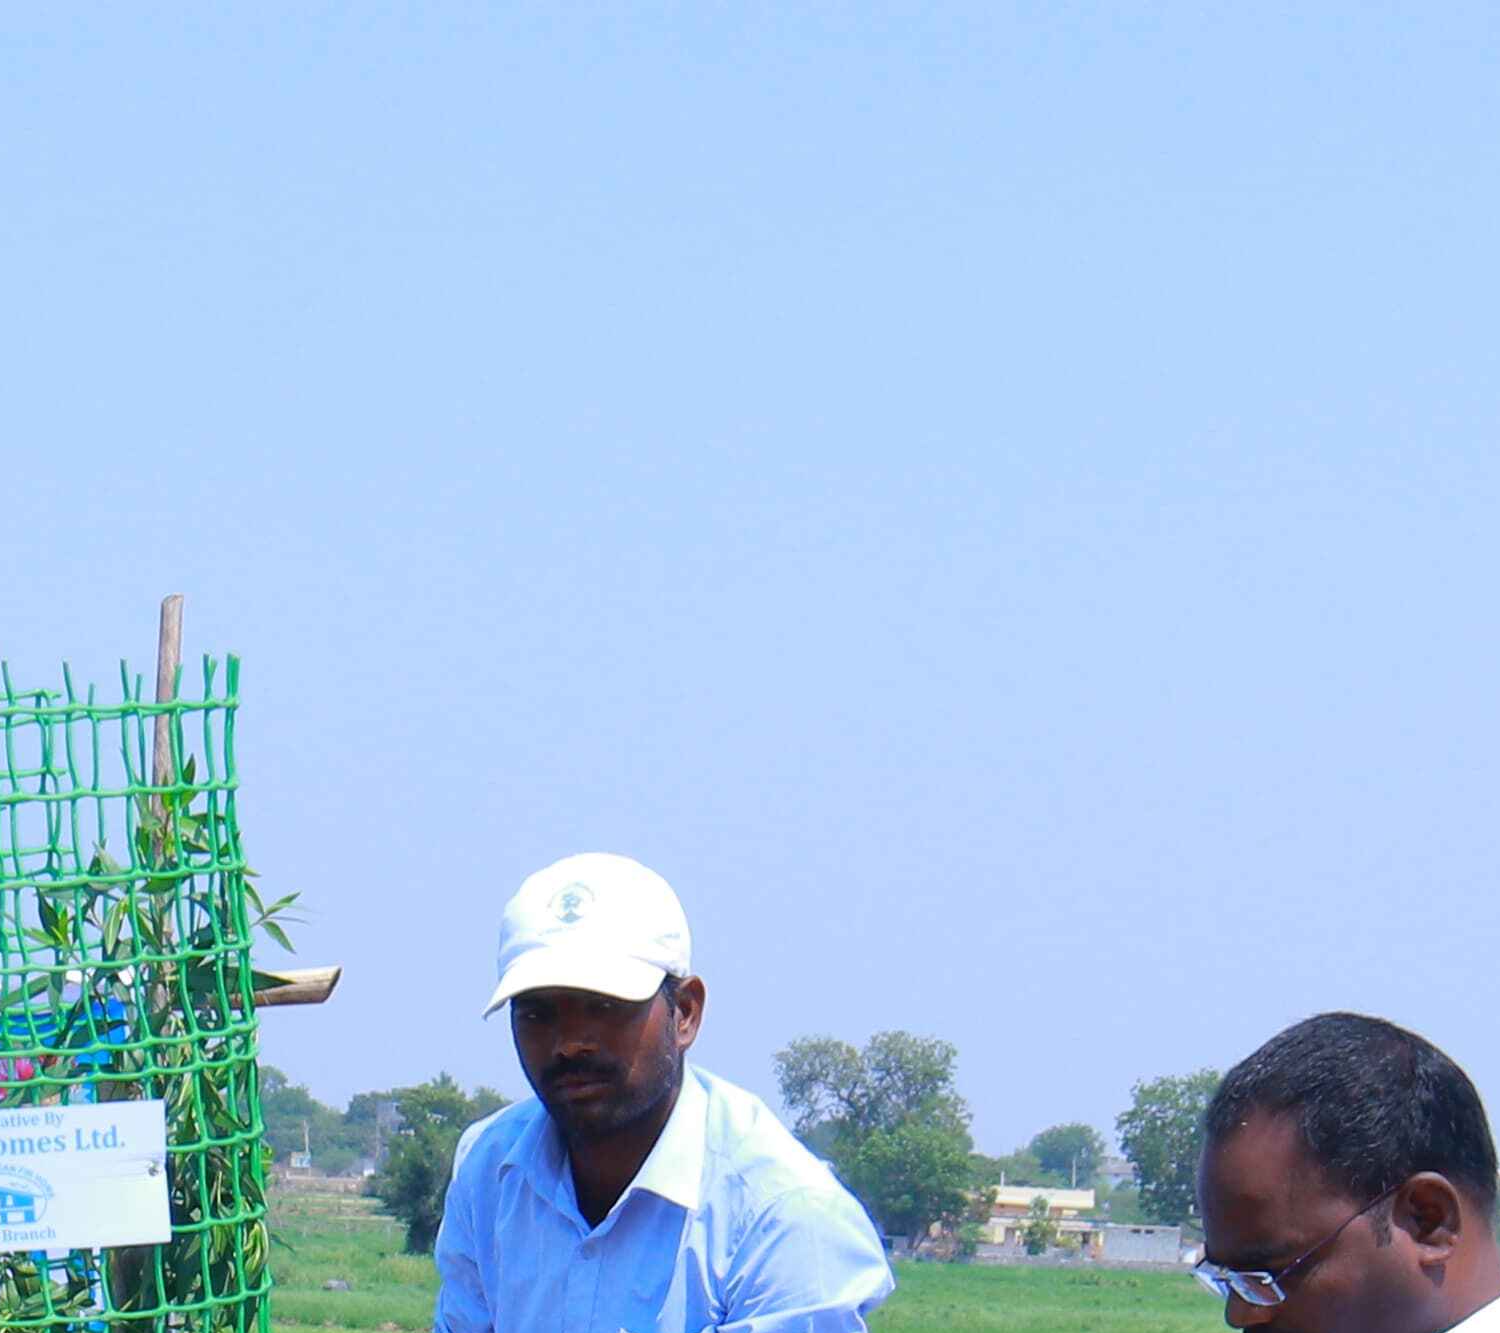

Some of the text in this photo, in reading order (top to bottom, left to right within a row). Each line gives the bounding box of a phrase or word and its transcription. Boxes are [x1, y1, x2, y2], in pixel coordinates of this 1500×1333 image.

[44, 1111, 65, 1128] By
[75, 1125, 127, 1152] Ltd.
[2, 1226, 57, 1242] Branch
